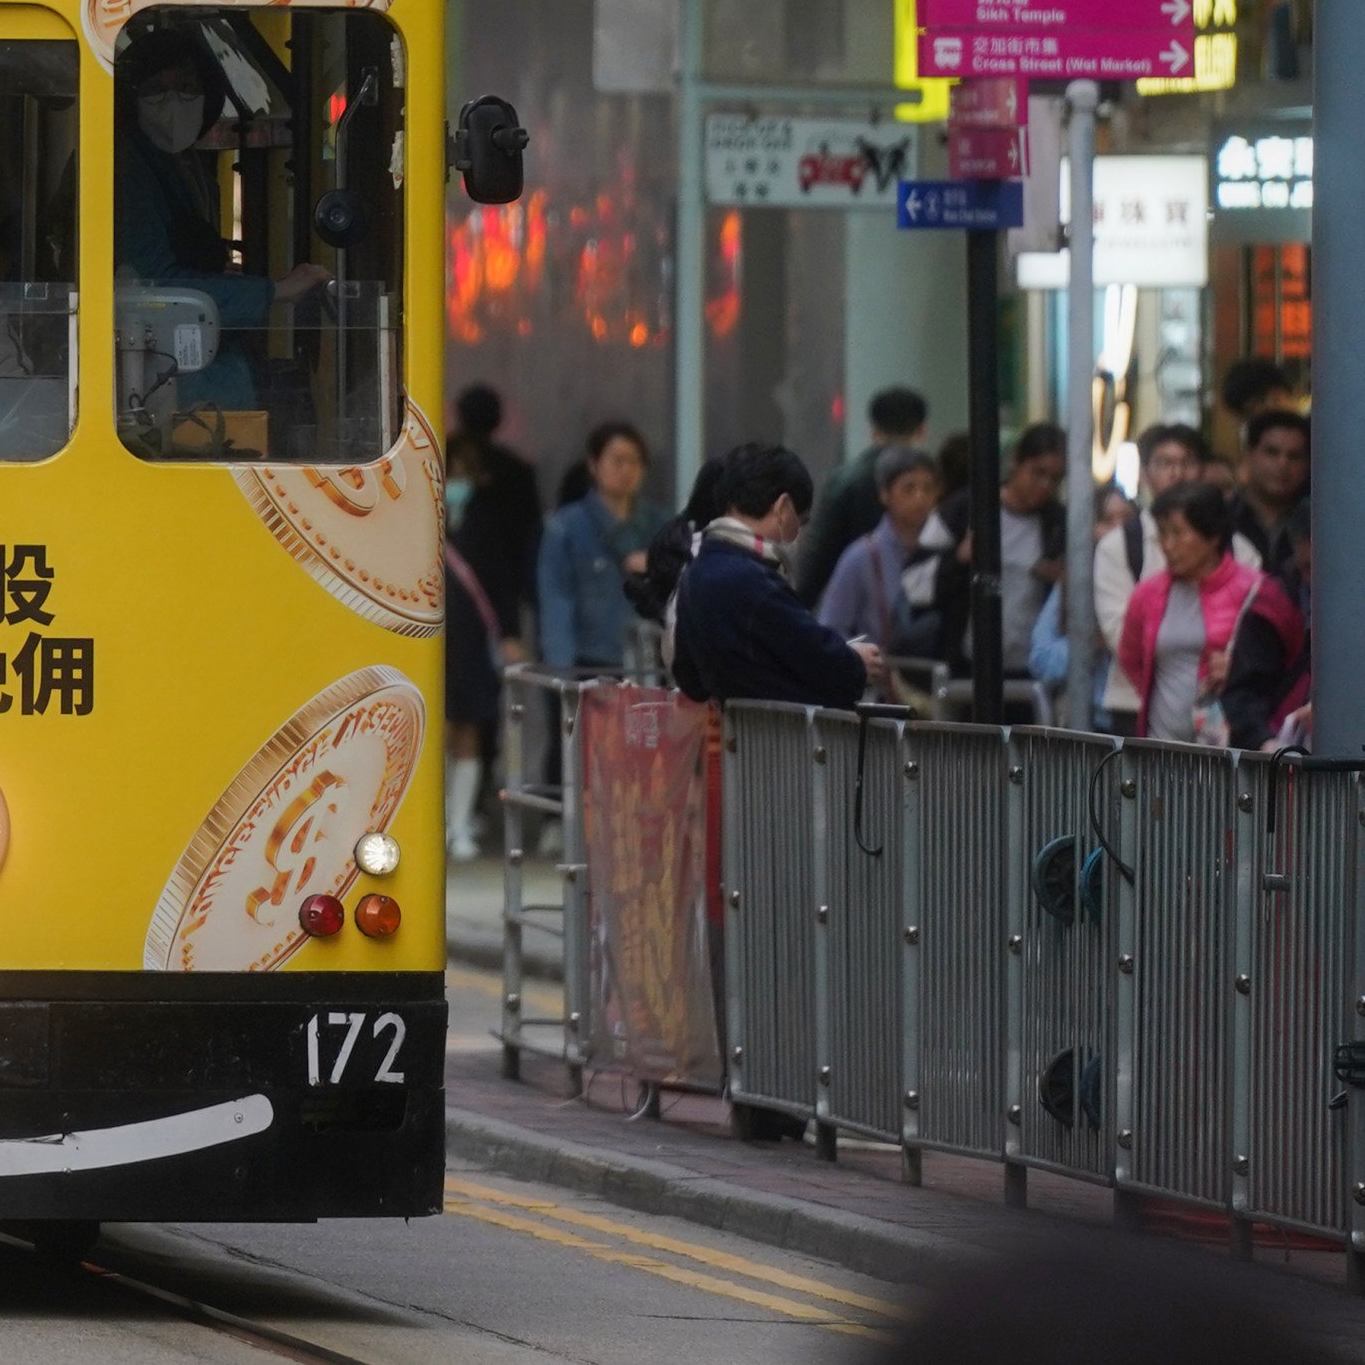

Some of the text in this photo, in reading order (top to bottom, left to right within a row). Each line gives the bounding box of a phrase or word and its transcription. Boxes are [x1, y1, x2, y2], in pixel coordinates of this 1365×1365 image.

[976, 9, 1066, 25] Sikh Temple
[972, 56, 1152, 74] Cross Street (Wet Market)
[304, 1012, 407, 1085] 172
